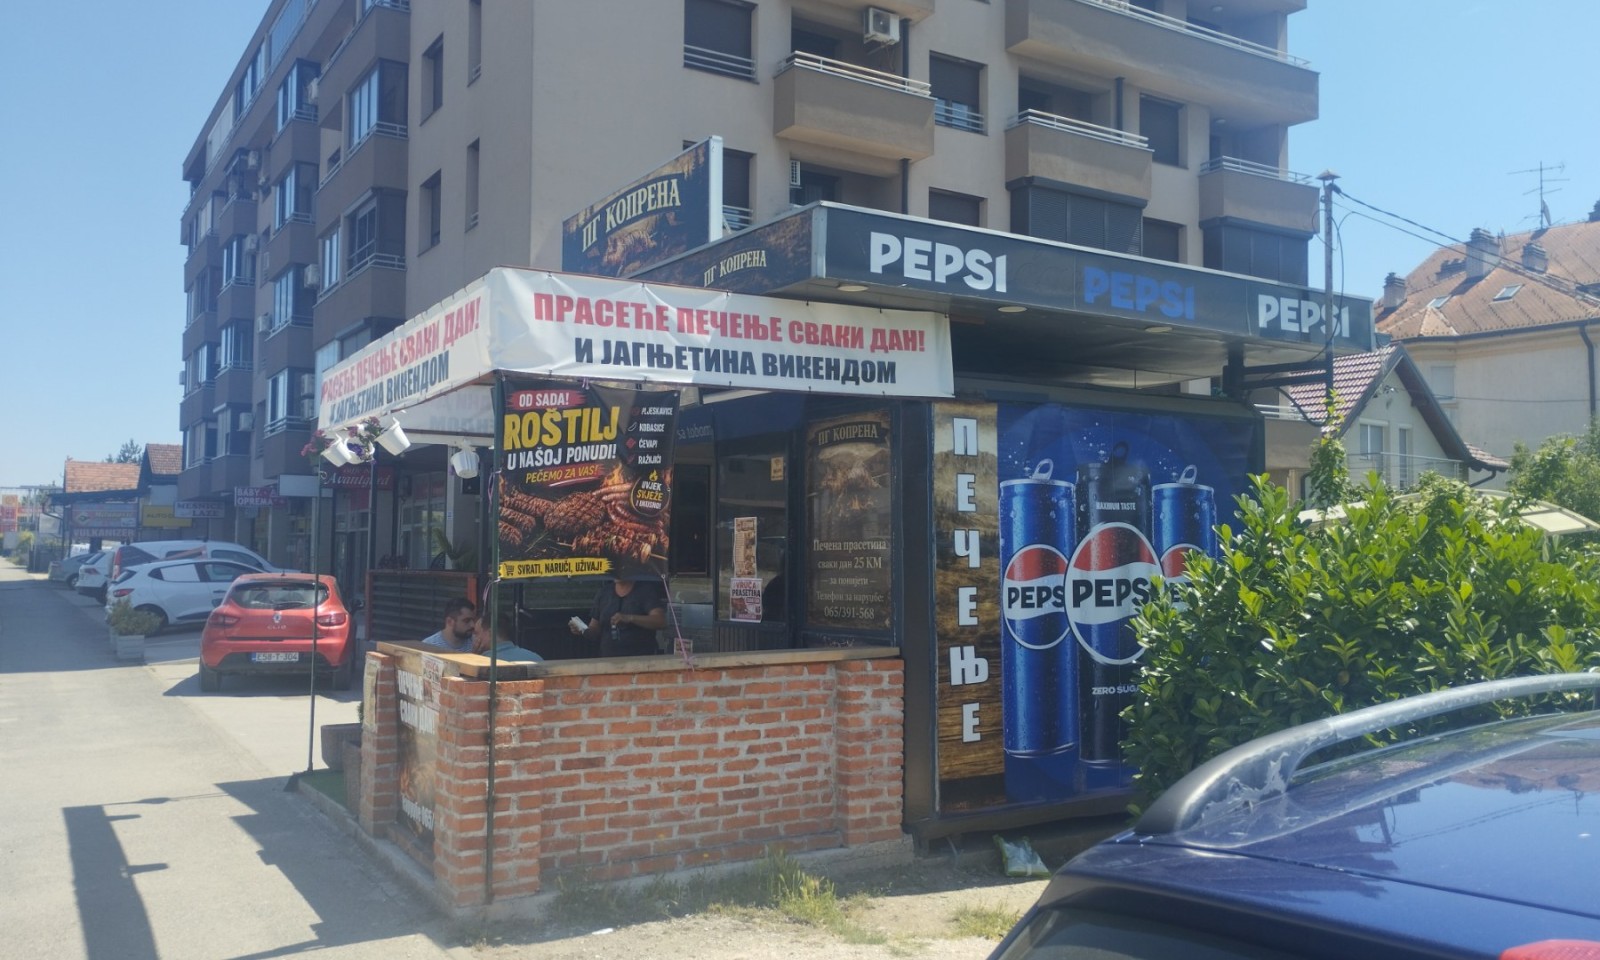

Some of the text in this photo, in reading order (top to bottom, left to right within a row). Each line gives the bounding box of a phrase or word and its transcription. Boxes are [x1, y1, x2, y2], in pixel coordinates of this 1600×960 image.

[582, 178, 681, 252] ПГ КОПРЕНА
[704, 250, 767, 287] ПГ КОПРЕНА
[870, 231, 1007, 293] PEPSI
[1083, 266, 1195, 320] PEPSI
[534, 293, 925, 353] ПРАСЕЋЕ ПЕЧЕЊЕ СВАКИ ДАН!
[1258, 294, 1350, 338] PEPSI
[321, 366, 355, 405] РАСЕЋЕ
[400, 320, 439, 367] СВАКИ
[575, 338, 896, 385] И ЈАГЊЕТИНА ВИКЕНДОМ
[387, 350, 449, 404] ВИКЕНДОМ
[519, 392, 569, 407] OD SADA!
[503, 406, 620, 450] ROŠTILJ
[639, 423, 665, 432] KOBASICE
[818, 424, 878, 445] ПГ КОПРЕНА
[507, 444, 617, 470] U NAŠOJ PONUDI!
[323, 472, 390, 488] Avantgrd
[525, 465, 600, 483] PEČEMO ZA VAS!
[237, 488, 259, 496] BABY
[237, 497, 273, 506] OPREMA
[1121, 502, 1136, 510] TASTE
[518, 565, 543, 576] SVRATI,
[576, 560, 602, 572] UŽIVAJ!
[853, 557, 865, 569] 25
[949, 417, 989, 743] ПЕЧЕЊЕ
[1073, 577, 1149, 608] PEPS
[1008, 585, 1064, 609] PEPS
[824, 606, 875, 619] 065/391-568
[1092, 684, 1139, 695] ZERO SUG
